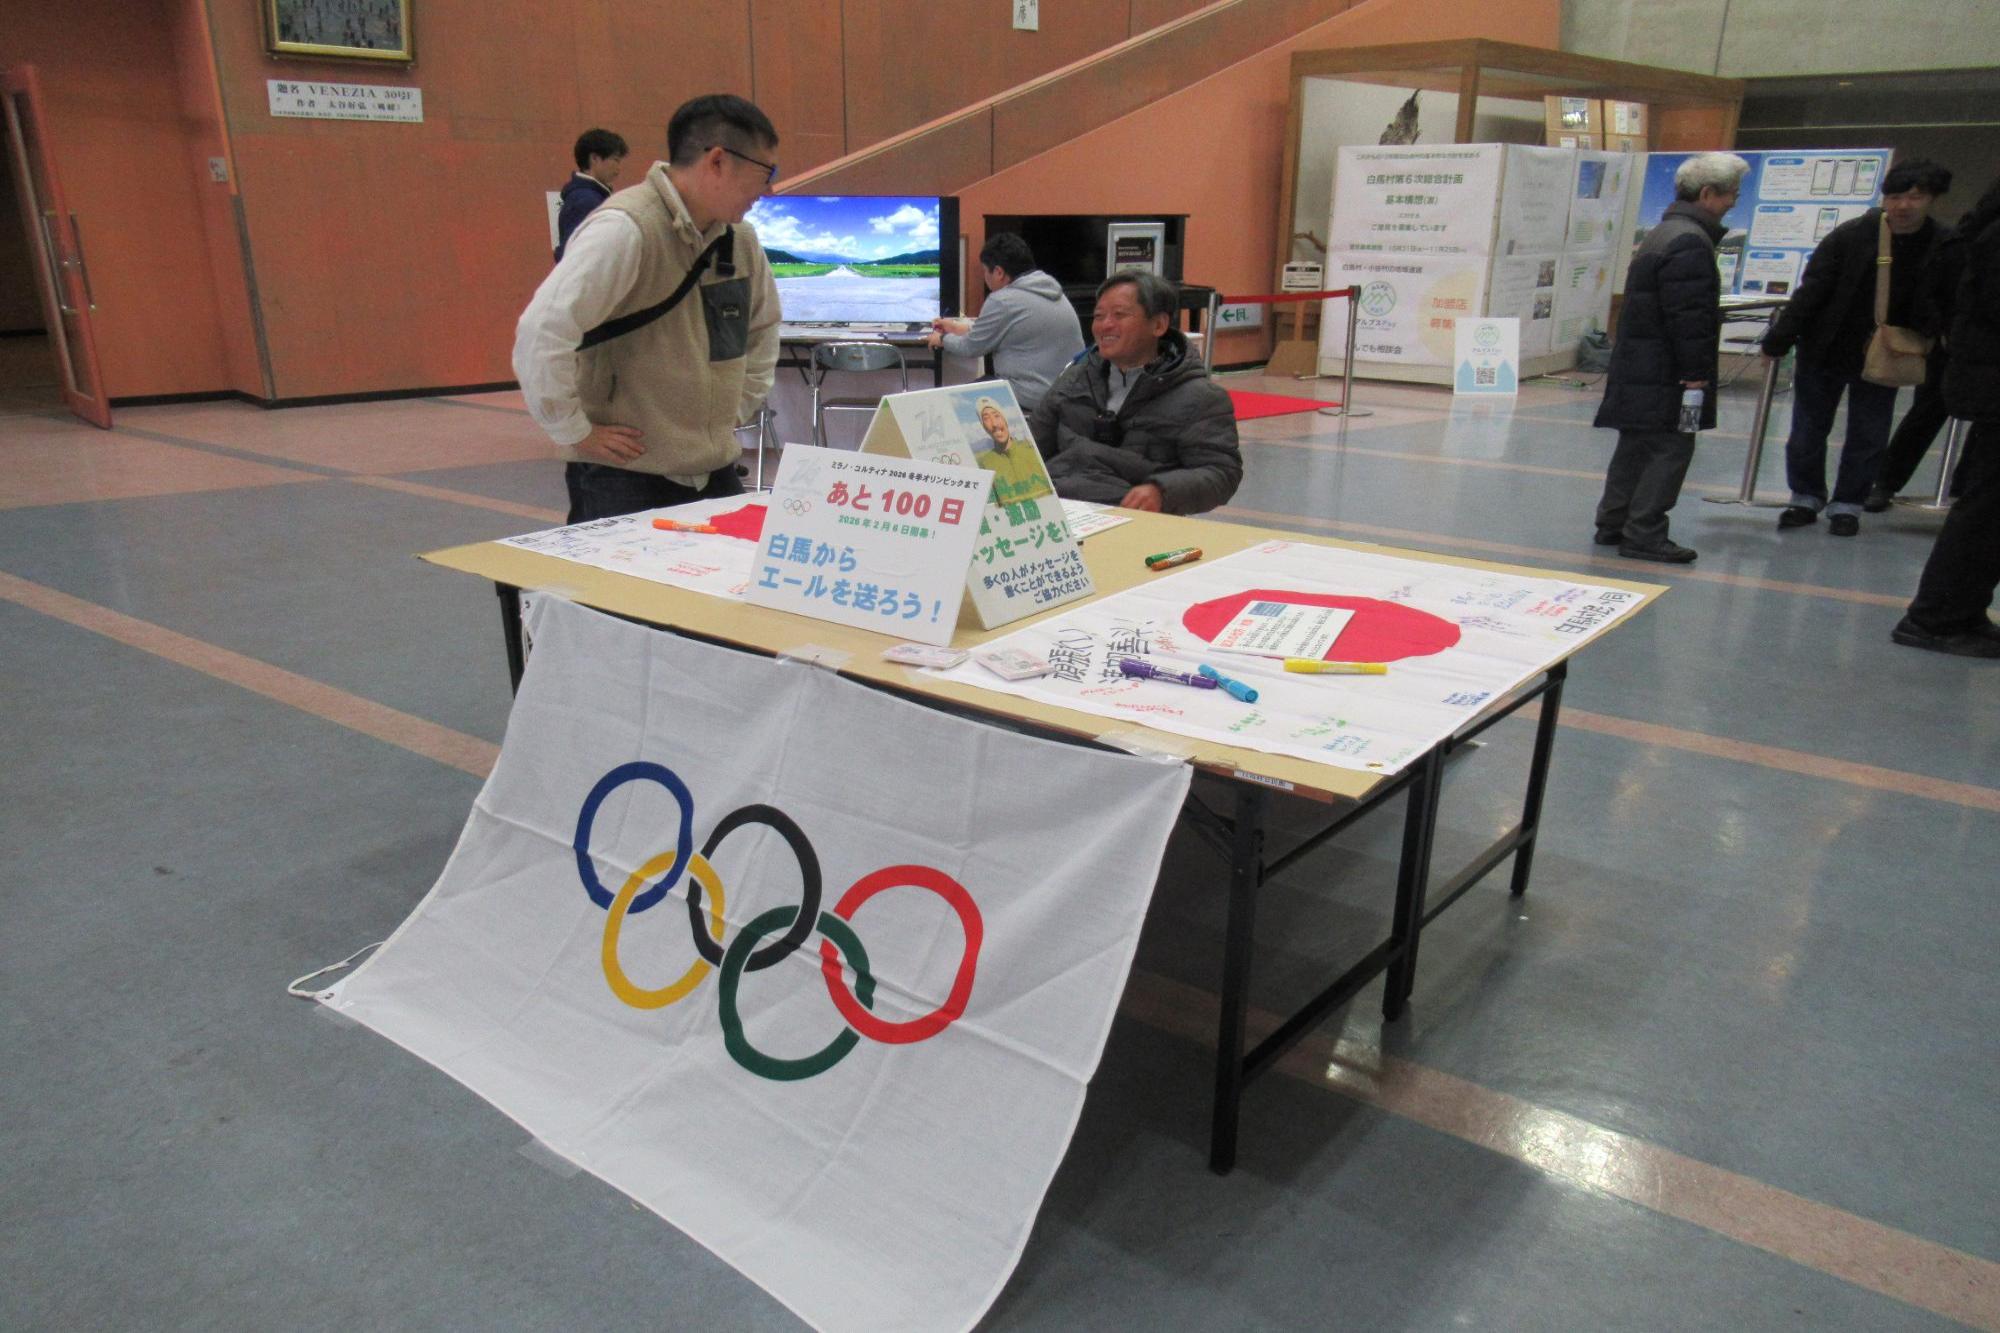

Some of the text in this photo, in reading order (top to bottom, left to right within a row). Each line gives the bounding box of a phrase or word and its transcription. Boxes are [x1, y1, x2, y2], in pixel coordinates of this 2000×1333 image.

[308, 85, 378, 98] VENEZIA
[1352, 343, 1403, 355] んでも相談会
[766, 532, 858, 574] 白馬から
[971, 519, 1071, 566] ッセージを!
[983, 550, 1079, 590] 多くの人がメッセージを
[1004, 562, 1084, 598] 書くことができるよう
[757, 565, 942, 624] エールを送ろう!
[1033, 577, 1089, 604] ご協力ください
